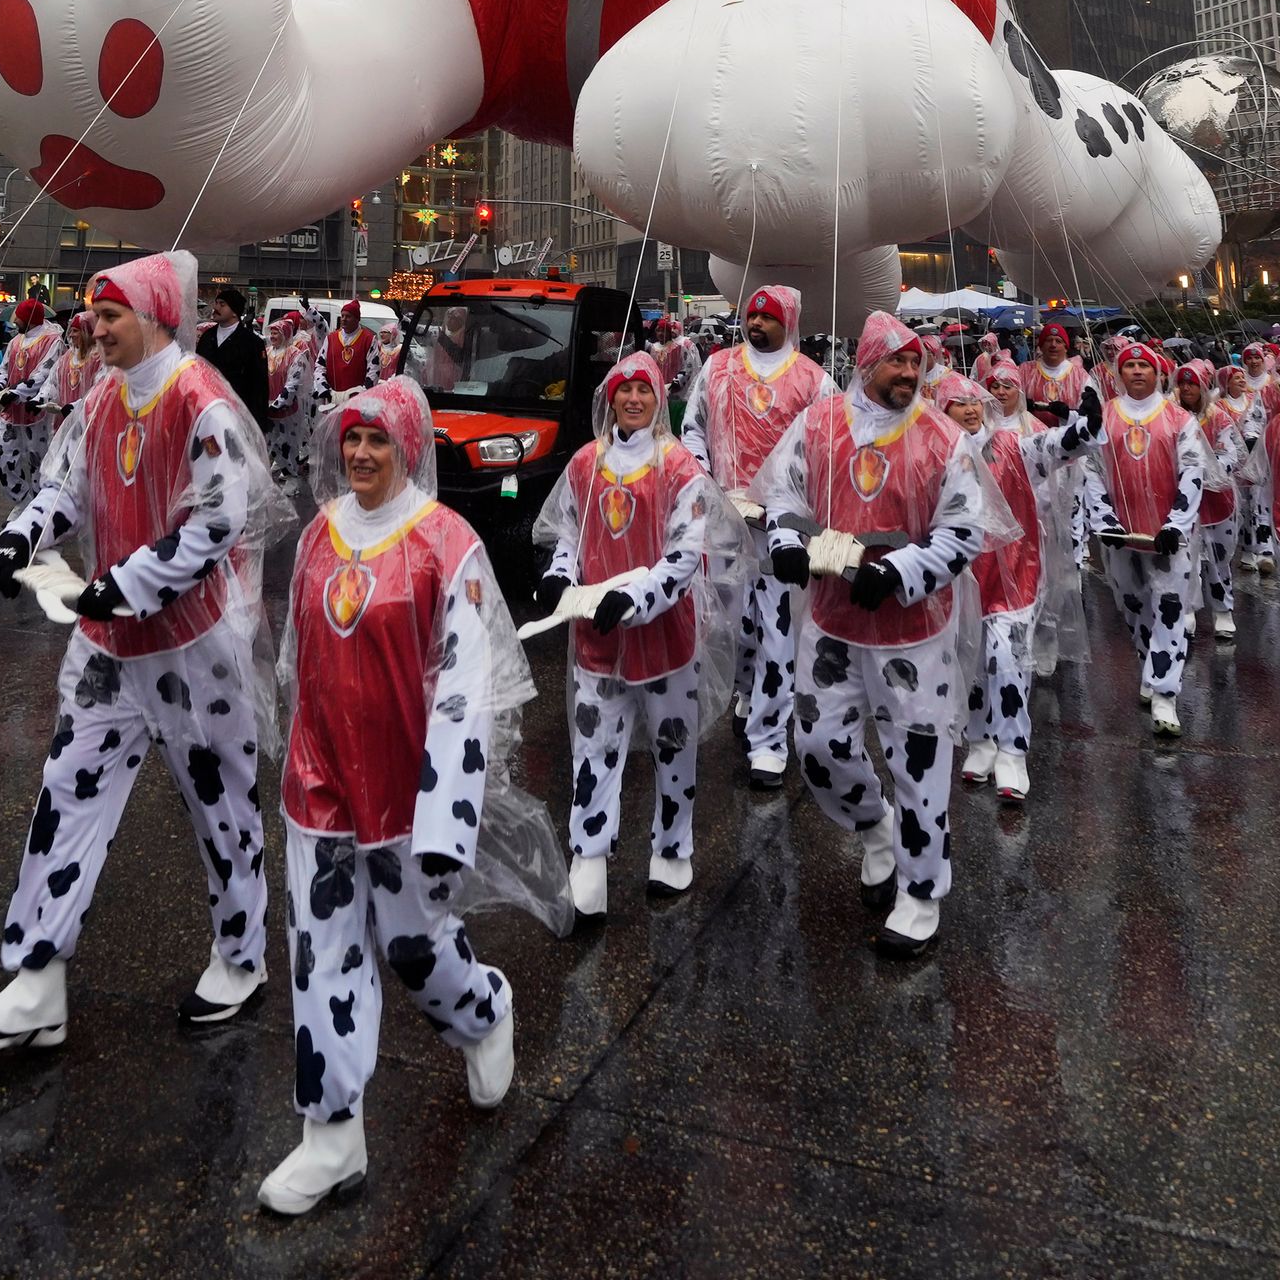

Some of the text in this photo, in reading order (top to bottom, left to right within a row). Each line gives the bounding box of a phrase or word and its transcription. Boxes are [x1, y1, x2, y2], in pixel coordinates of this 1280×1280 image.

[407, 239, 458, 273] jazz
[493, 241, 538, 273] jazz
[659, 251, 671, 260] 25
